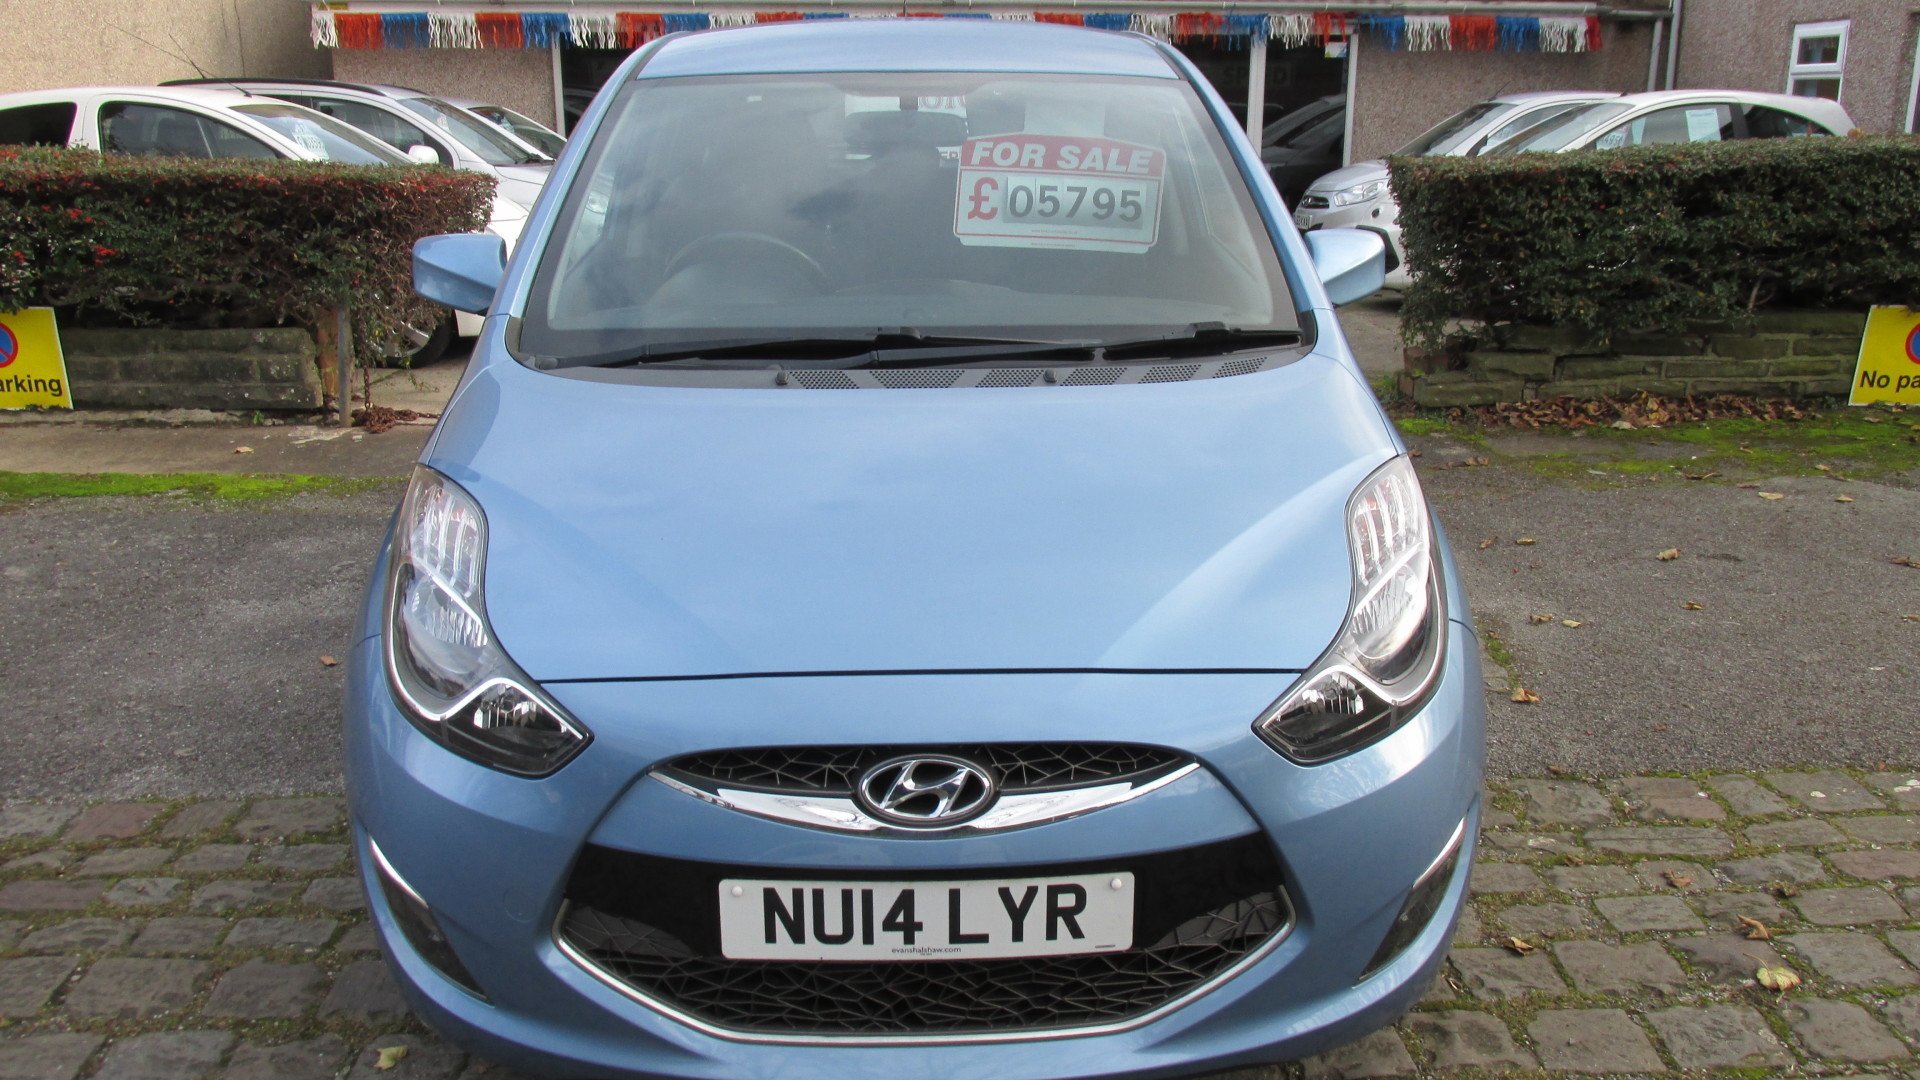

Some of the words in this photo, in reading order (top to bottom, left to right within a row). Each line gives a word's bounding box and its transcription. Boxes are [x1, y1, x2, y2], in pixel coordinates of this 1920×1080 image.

[970, 141, 1046, 168] FOR
[1057, 145, 1153, 174] SALE
[1859, 370, 1890, 389] No
[763, 887, 924, 945] NU14
[948, 883, 1086, 945] LYR
[891, 946, 962, 955] evanshalshaw.com
